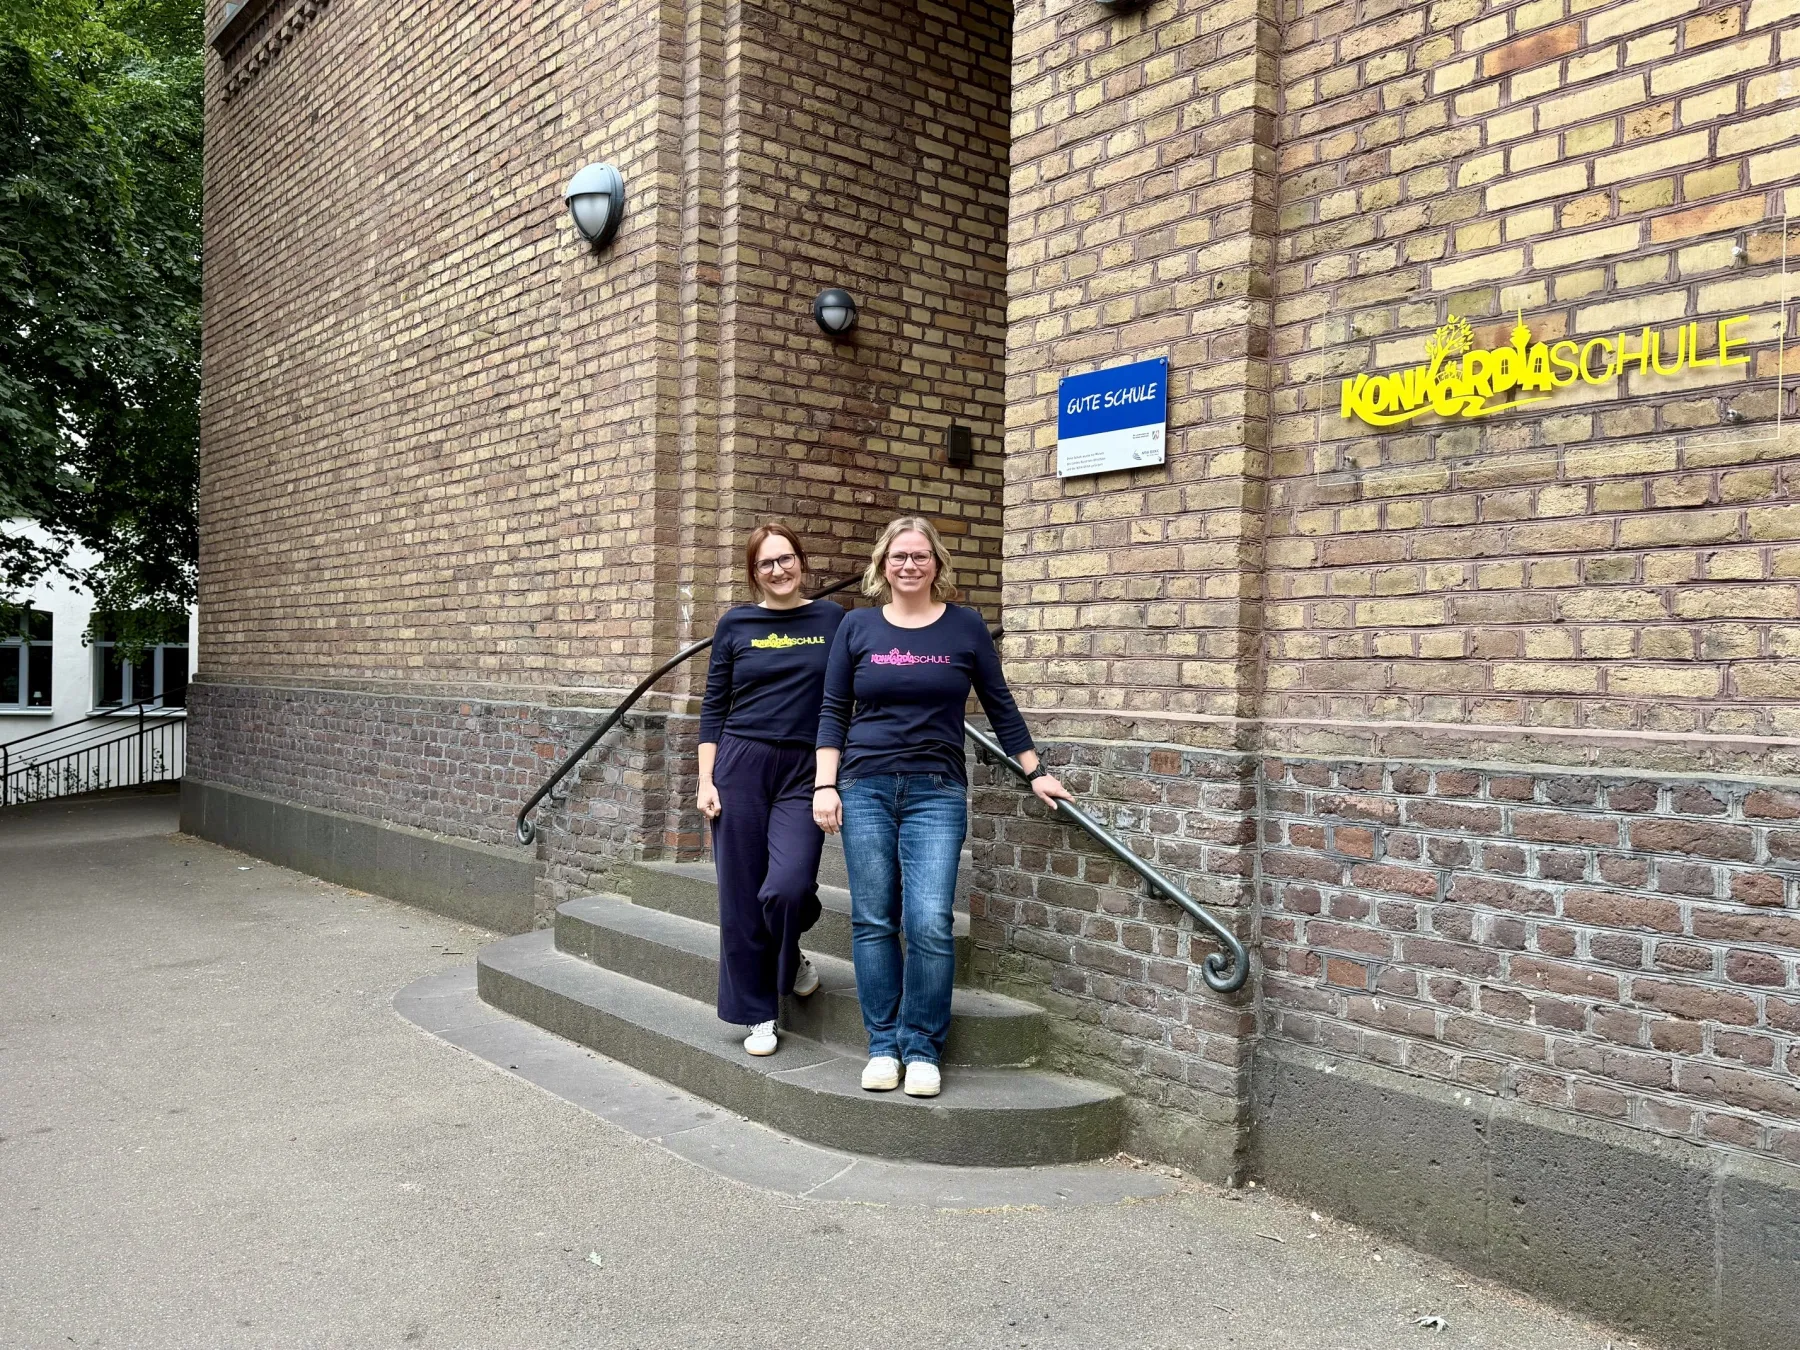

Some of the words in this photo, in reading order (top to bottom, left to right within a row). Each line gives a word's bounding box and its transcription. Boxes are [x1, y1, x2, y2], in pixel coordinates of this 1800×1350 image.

[1066, 393, 1102, 415] GUTE
[1104, 382, 1158, 408] SCHULE
[1340, 312, 1751, 426] KONKORDIASCHULE
